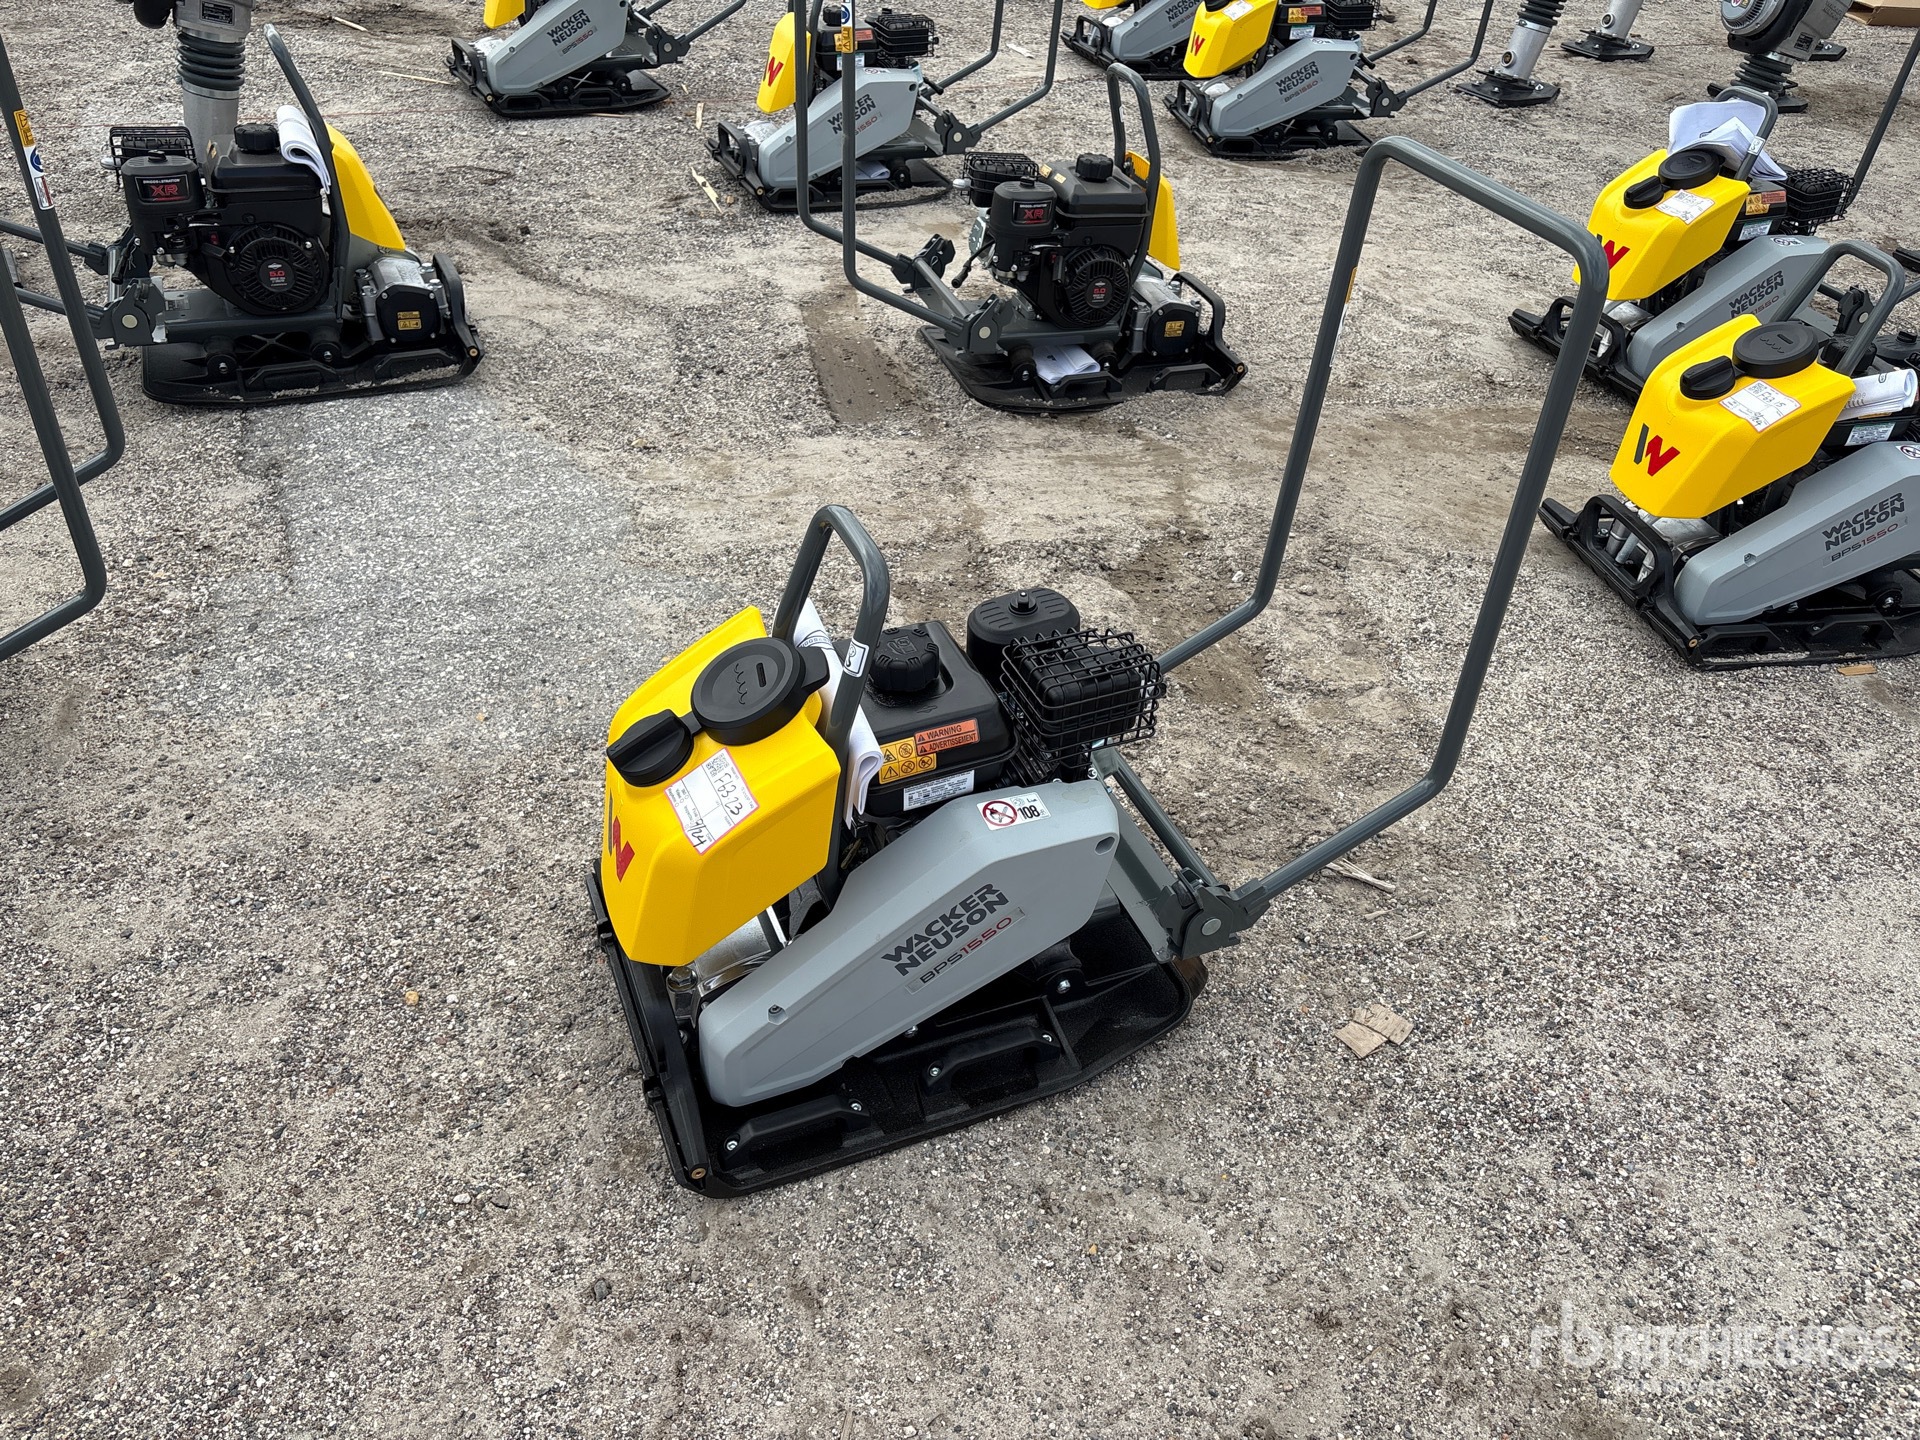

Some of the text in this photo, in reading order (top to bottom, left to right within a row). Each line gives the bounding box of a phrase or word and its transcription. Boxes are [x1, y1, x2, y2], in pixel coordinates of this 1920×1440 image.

[547, 9, 586, 38] WACKER
[552, 16, 591, 46] NEUSON
[562, 29, 593, 54] BPS1550
[1275, 61, 1317, 87] WACKER
[1278, 67, 1320, 95] NEUSON
[1284, 80, 1319, 102] BPS1550
[150, 184, 178, 197] XR
[1023, 208, 1044, 219] XR
[1729, 270, 1783, 309] WACKER
[1730, 277, 1784, 319] NEUSON
[1822, 492, 1905, 539] WACKER
[1824, 501, 1905, 551] NEUSON
[1831, 523, 1899, 562] BPS1550
[926, 725, 962, 740] WARNING
[929, 733, 976, 751] ADVERTISSEMENT
[1017, 805, 1040, 820] 108
[881, 883, 1001, 962] WACKER
[894, 891, 1010, 977] NEUSON
[919, 917, 1012, 984] BPS1550
